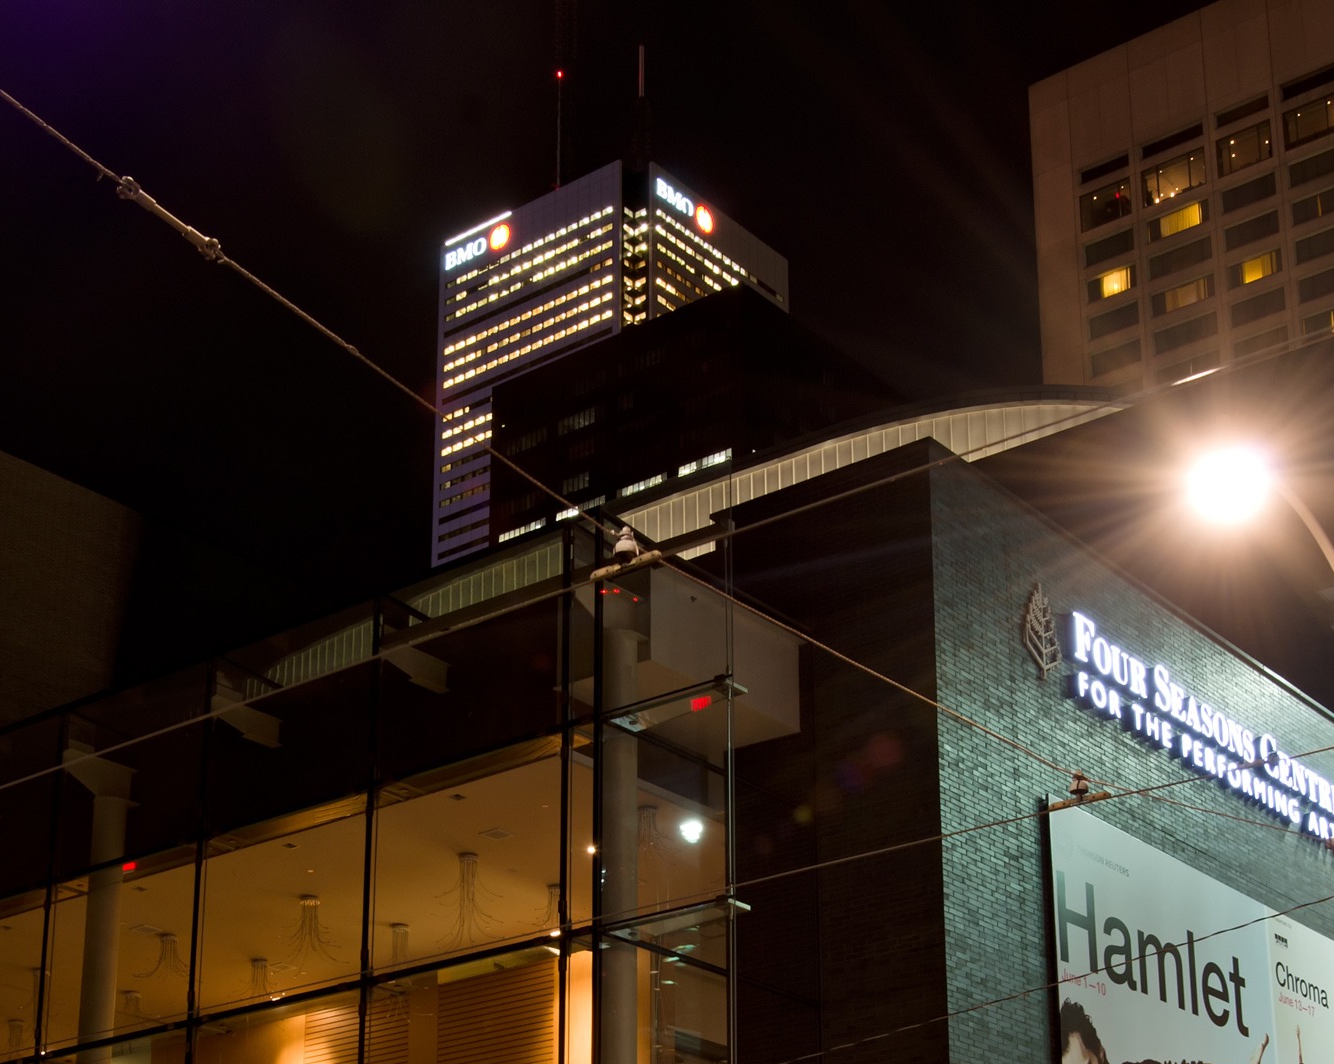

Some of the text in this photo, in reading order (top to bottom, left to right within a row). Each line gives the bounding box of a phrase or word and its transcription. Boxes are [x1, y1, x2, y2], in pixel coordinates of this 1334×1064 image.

[656, 178, 694, 217] BMO
[444, 237, 487, 270] BMO
[1072, 611, 1147, 699] FOUR
[1154, 664, 1255, 763] SEASONS
[1078, 671, 1121, 718] FOR
[1132, 703, 1172, 748] THE
[1182, 733, 1301, 824] PERFORMING
[1056, 870, 1249, 1037] Hamlet
[1275, 961, 1329, 1009] Chroma
